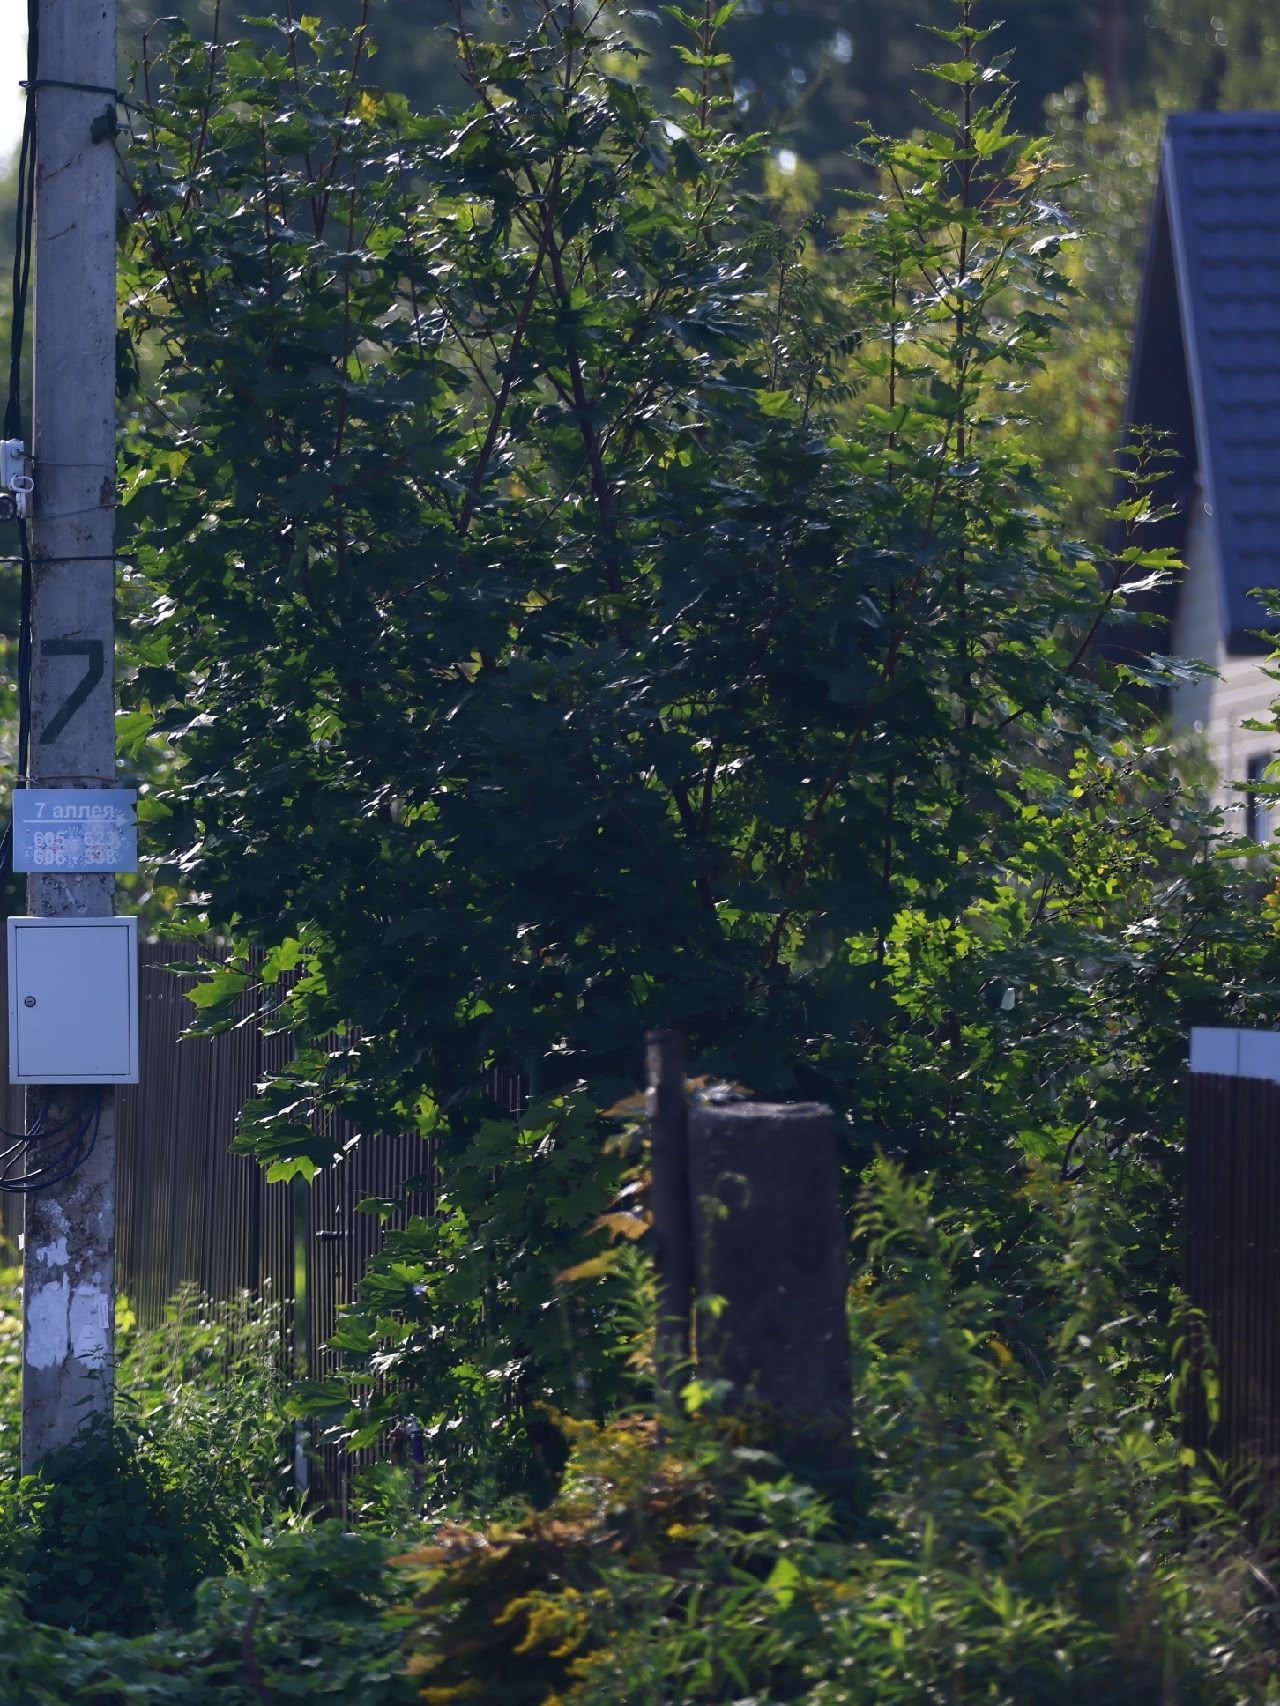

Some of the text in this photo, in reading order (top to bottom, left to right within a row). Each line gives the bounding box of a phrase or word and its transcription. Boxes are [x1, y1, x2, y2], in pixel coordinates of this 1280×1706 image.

[40, 639, 105, 745] 7
[35, 802, 115, 819] 7 аллея
[33, 831, 65, 847] 605
